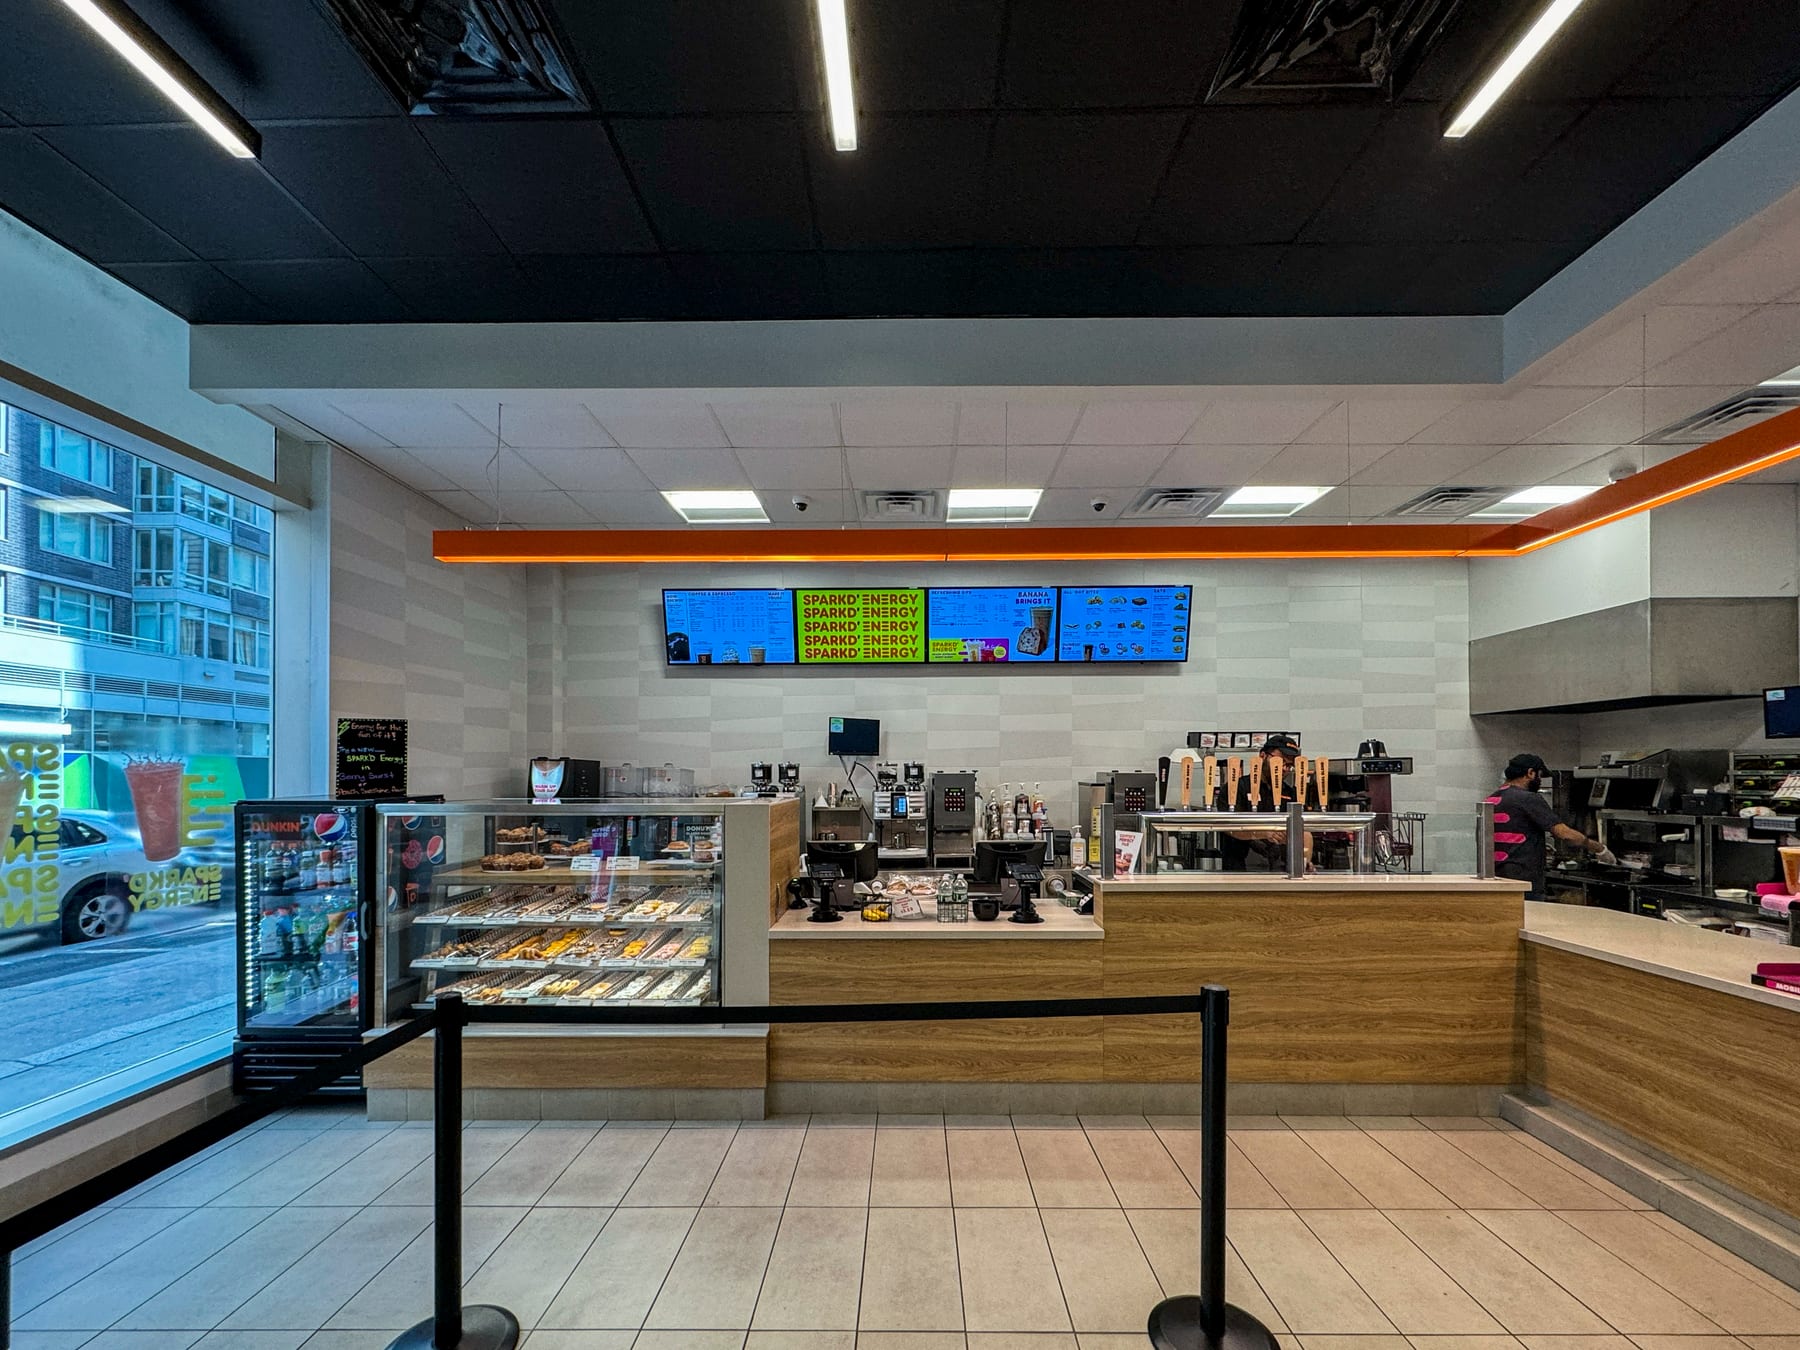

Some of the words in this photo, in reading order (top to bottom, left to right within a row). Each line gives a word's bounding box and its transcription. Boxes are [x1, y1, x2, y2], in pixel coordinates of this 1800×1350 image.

[803, 594, 860, 605] SPARKD'
[862, 594, 918, 604] ENERGY
[803, 607, 860, 618] SPARKD'
[862, 606, 918, 617] ENERGY
[804, 621, 860, 632] SPARKD'
[862, 620, 918, 631] ENERGY
[805, 635, 861, 646] SPARKD'
[862, 634, 918, 645] ENERGY
[805, 648, 861, 659] SPARKD'
[862, 647, 918, 658] ENERGY
